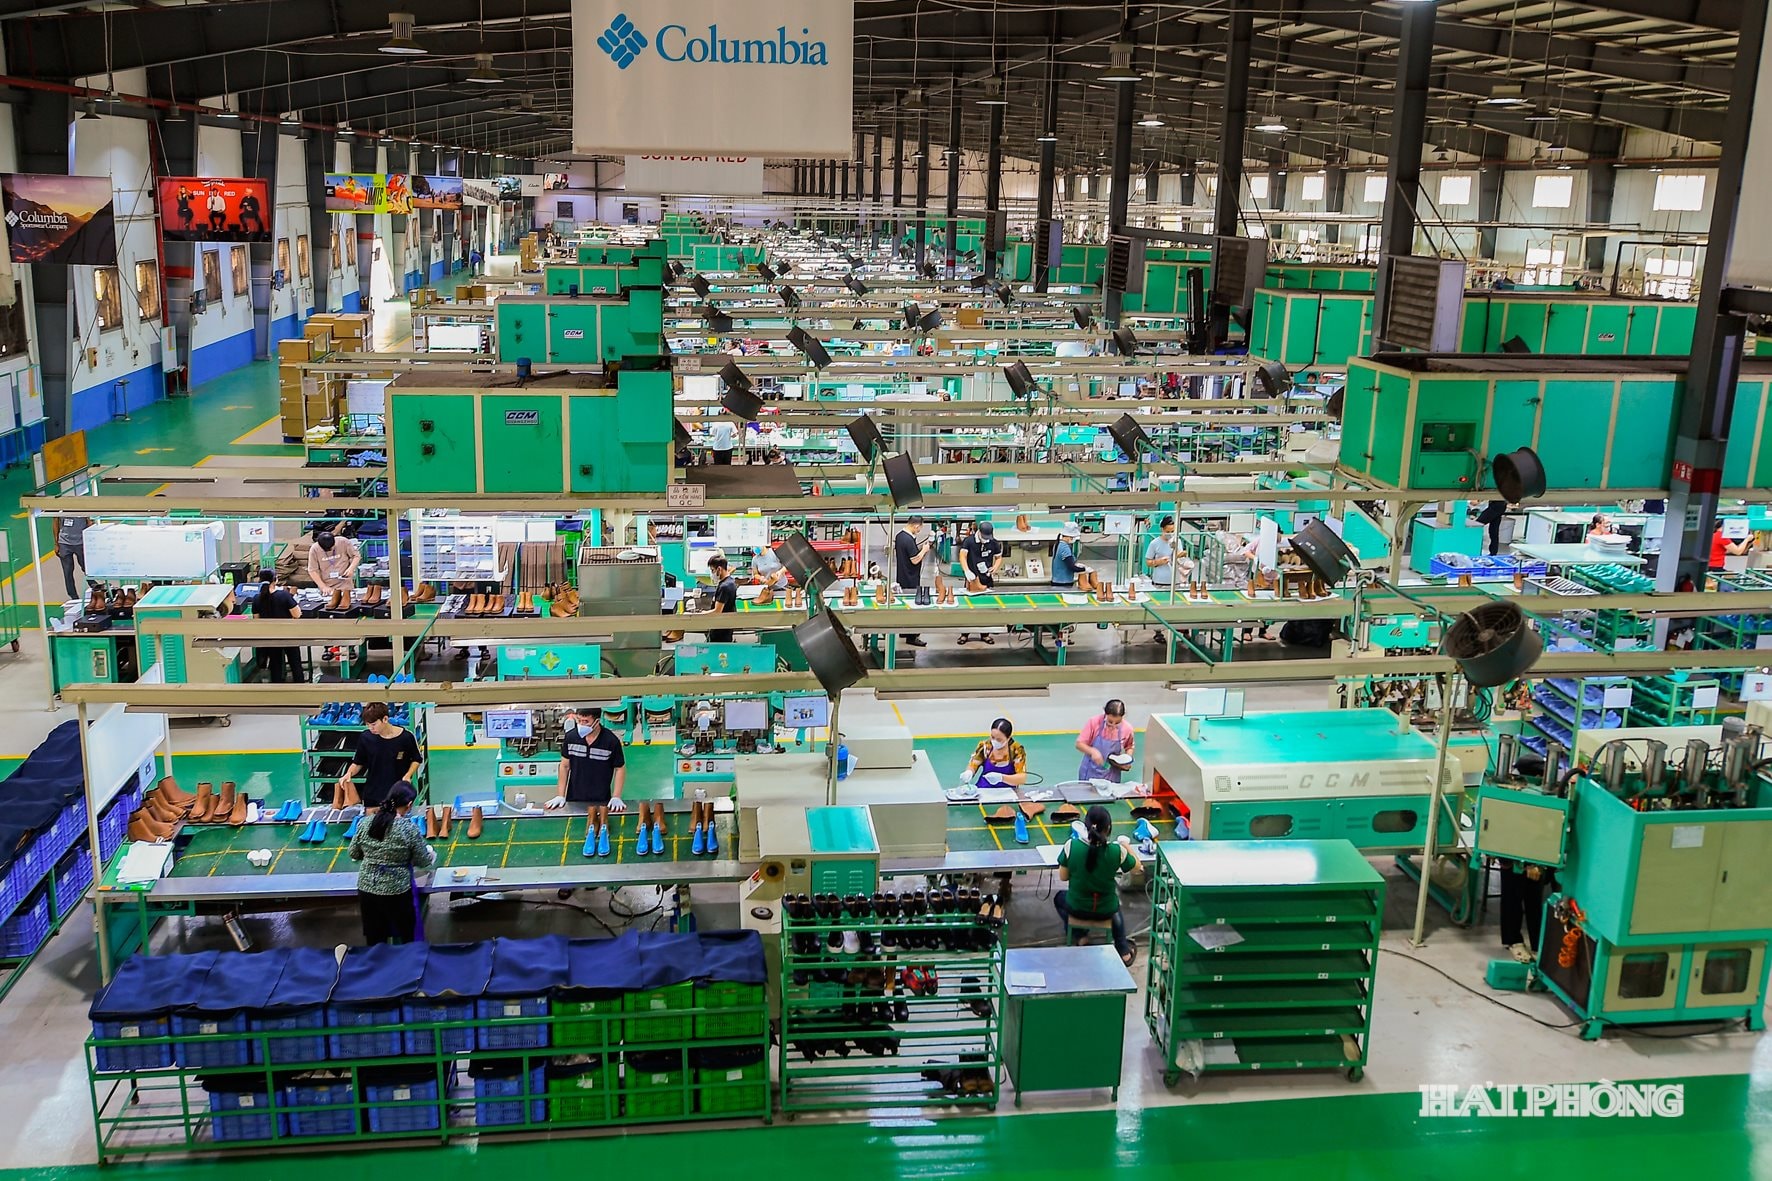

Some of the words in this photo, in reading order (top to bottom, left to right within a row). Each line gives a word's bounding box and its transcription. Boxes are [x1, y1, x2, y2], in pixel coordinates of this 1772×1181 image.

[655, 24, 829, 66] Columbia
[19, 210, 68, 224] Columbia
[506, 411, 537, 420] CCM
